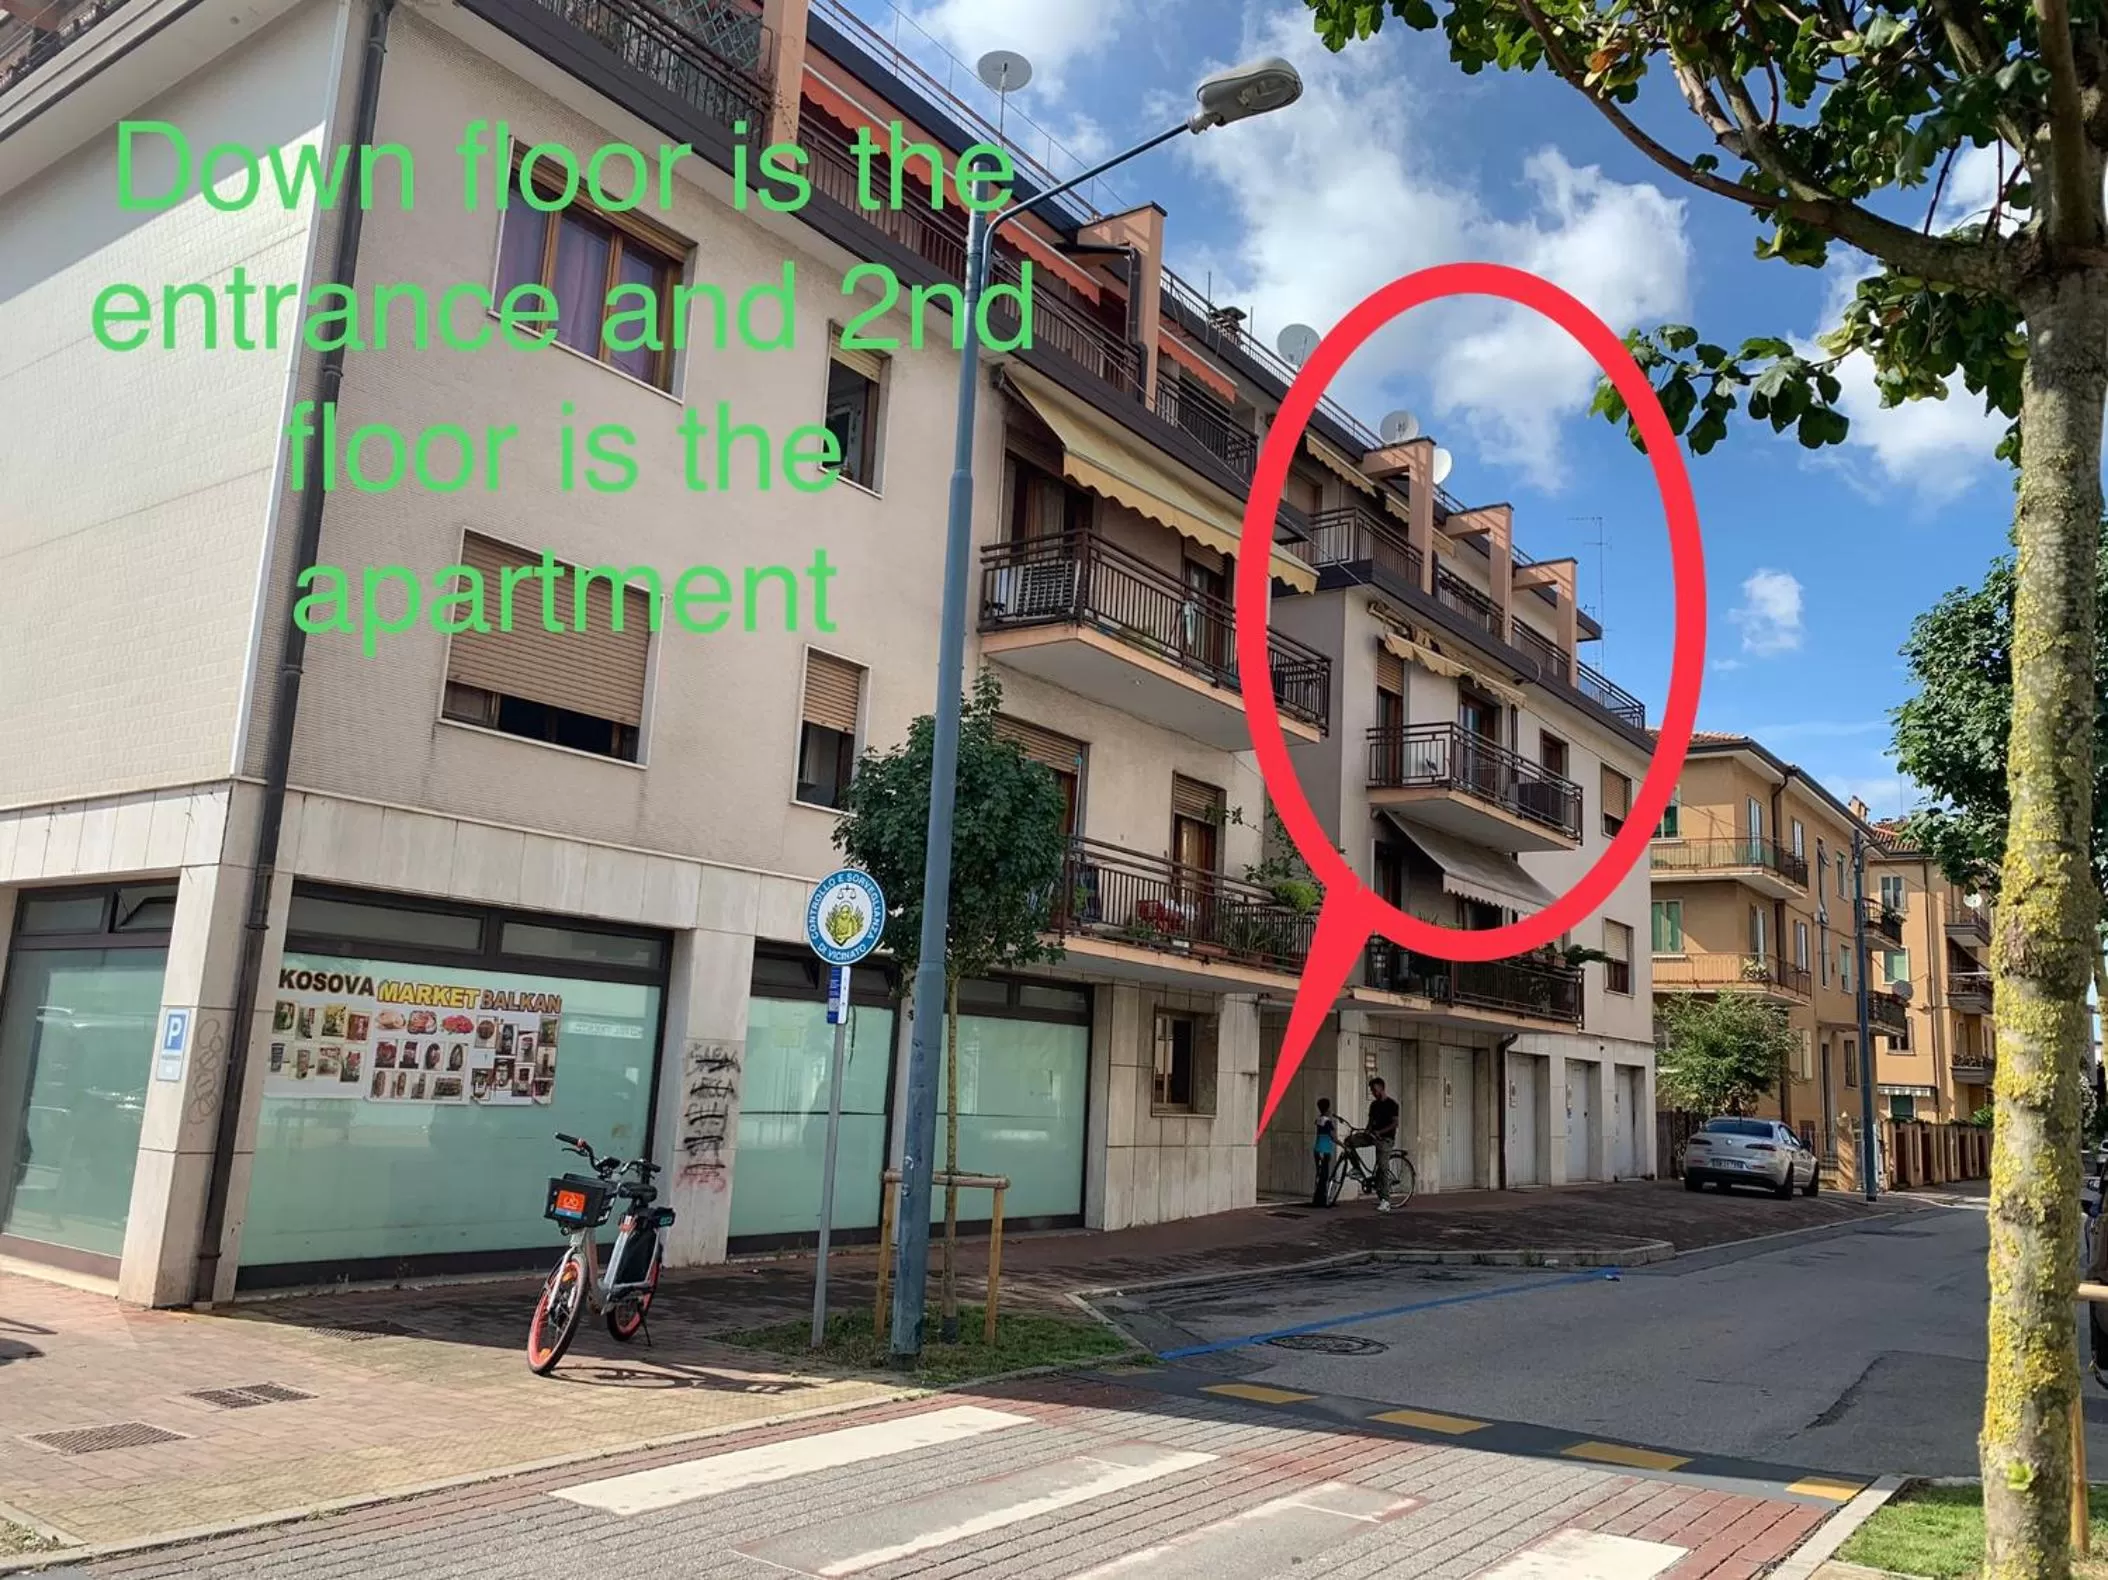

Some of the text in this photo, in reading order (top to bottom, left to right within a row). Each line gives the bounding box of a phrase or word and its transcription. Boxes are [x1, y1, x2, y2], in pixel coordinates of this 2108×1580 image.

[808, 878, 836, 940] CONTROLLO
[837, 874, 844, 882] E
[828, 944, 867, 961] VICINATO
[278, 967, 563, 1014] KOSOVA MARKET BALKAN
[167, 1016, 183, 1048] P
